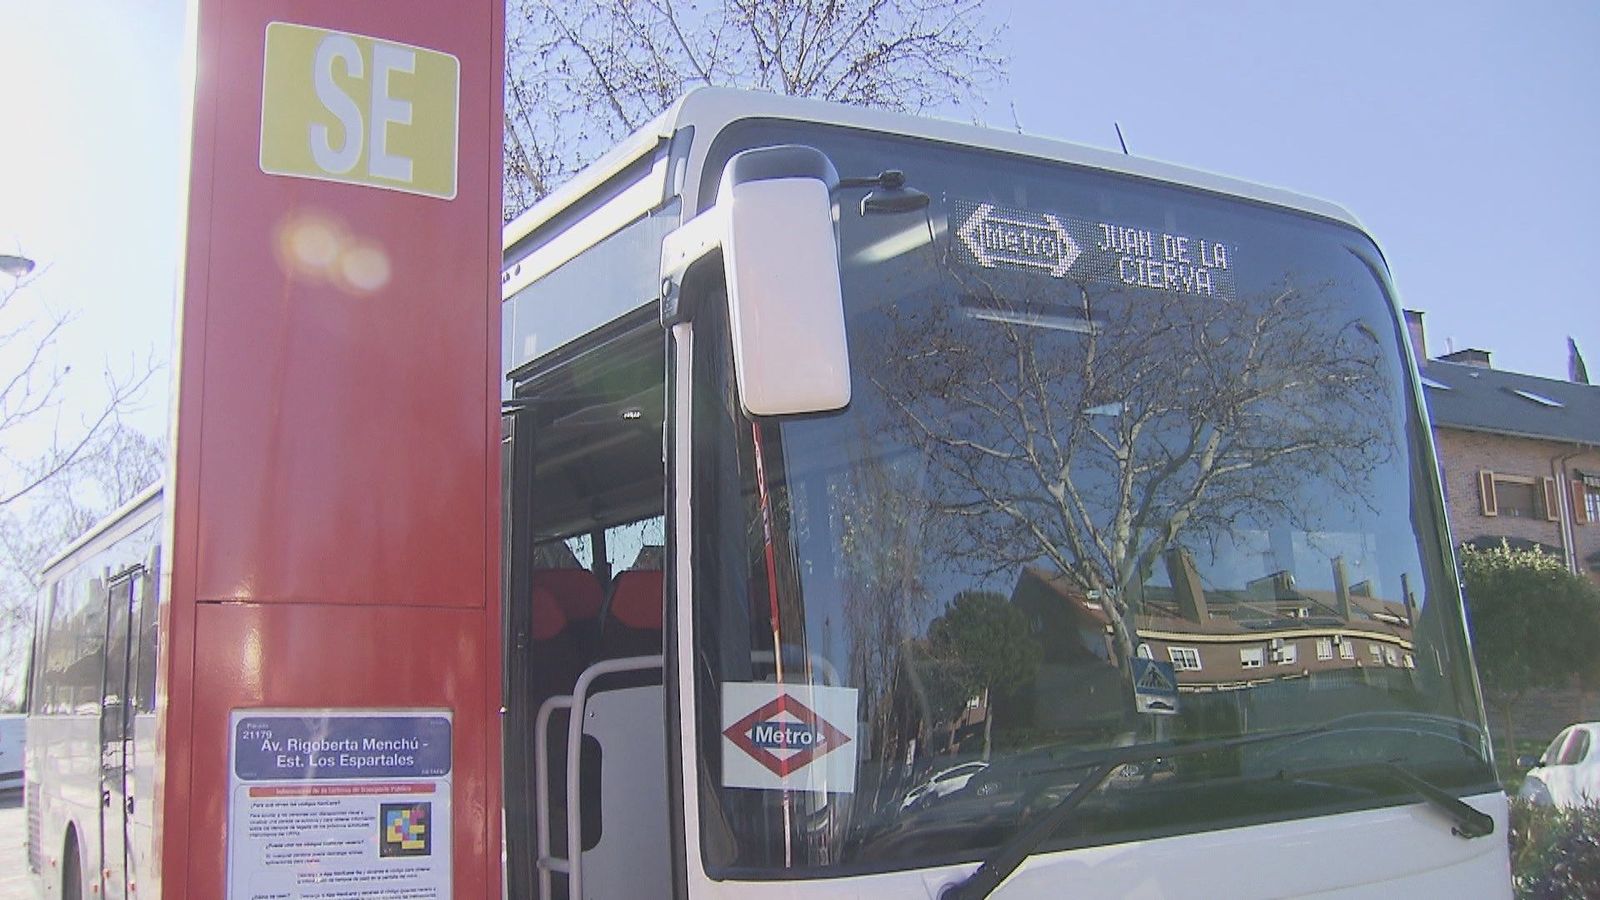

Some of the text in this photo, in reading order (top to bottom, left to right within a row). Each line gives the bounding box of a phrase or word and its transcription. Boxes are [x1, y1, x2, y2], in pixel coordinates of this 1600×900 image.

[309, 33, 416, 183] SE
[985, 223, 1055, 258] Metro
[1097, 223, 1227, 270] JUAN DE LA
[1119, 256, 1212, 296] CIERVA
[242, 730, 273, 740] 21179
[261, 739, 283, 752] Av.
[287, 738, 359, 754] Rigoberta
[363, 736, 419, 751] Menchú
[755, 726, 813, 745] Metro
[276, 753, 414, 769] Est. Los Espartales
